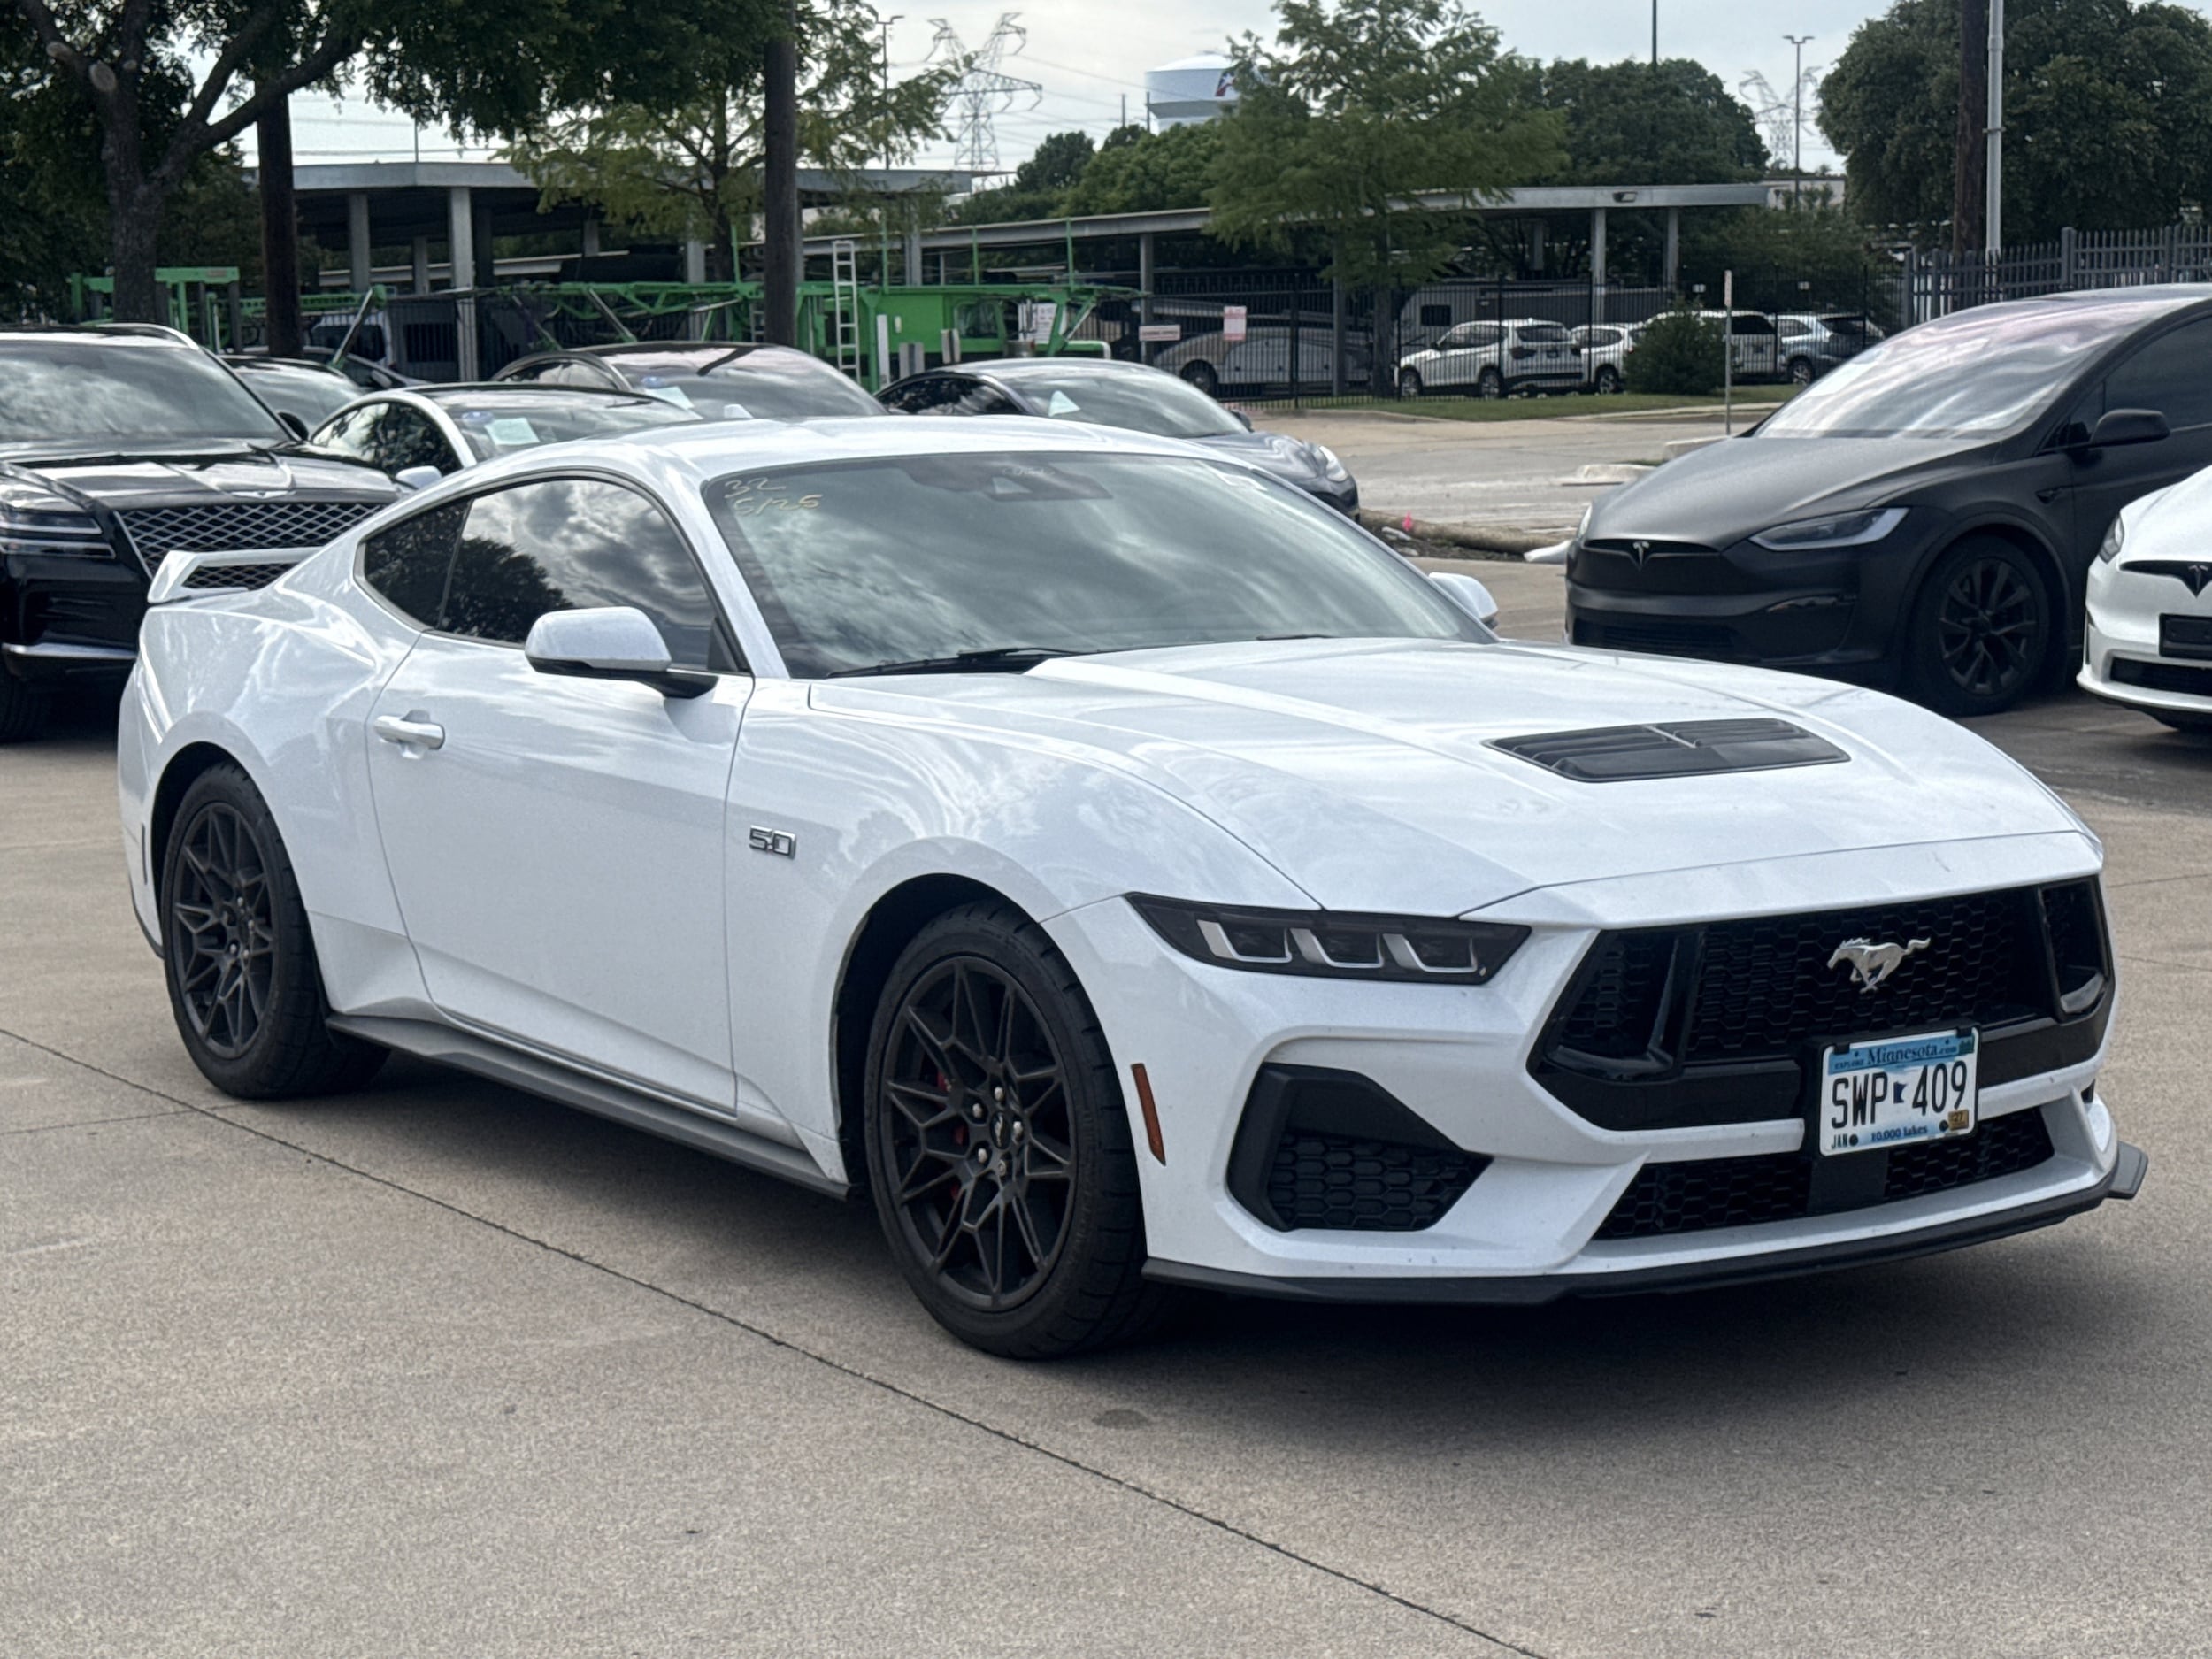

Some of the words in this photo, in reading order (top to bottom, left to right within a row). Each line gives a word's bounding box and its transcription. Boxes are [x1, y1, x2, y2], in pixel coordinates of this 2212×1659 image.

[1832, 1071, 1888, 1129] SWP
[1912, 1061, 1967, 1116] 409
[1831, 1133, 1848, 1149] JAN
